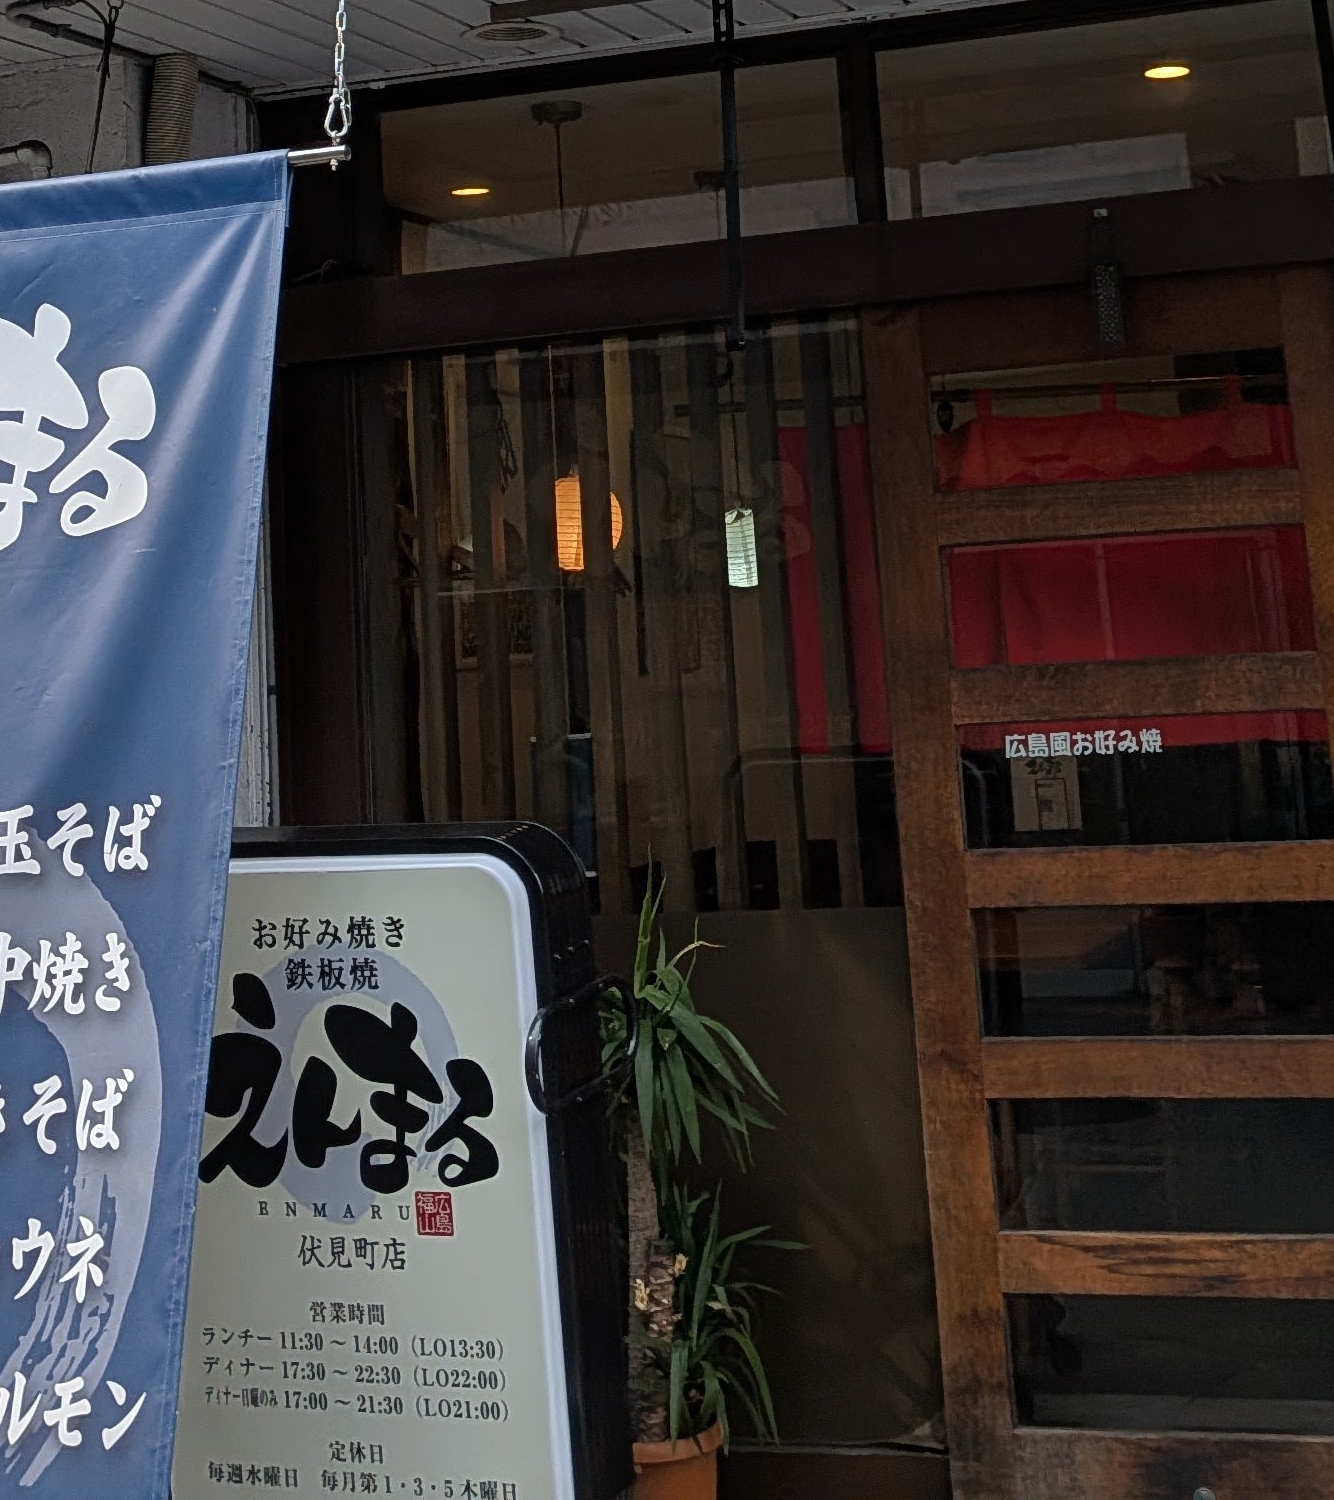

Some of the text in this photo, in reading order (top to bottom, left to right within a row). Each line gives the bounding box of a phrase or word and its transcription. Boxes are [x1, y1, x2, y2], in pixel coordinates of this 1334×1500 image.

[1005, 728, 1163, 758] 広島風お好み焼
[252, 915, 406, 950] お好み焼き
[284, 957, 380, 991] 鉄板焼
[198, 972, 500, 1194] えんまる
[258, 1200, 410, 1221] ENMARU
[297, 1233, 407, 1271] 伏見町店
[309, 1301, 385, 1326] 営業時間
[202, 1327, 272, 1347] ランチー
[280, 1331, 323, 1350] 11:30
[353, 1334, 399, 1355] 14:00
[203, 1356, 273, 1377] ディナー
[282, 1361, 326, 1381] 17:30
[354, 1364, 401, 1385] 22:30
[284, 1390, 328, 1411] 17:00
[356, 1394, 403, 1415] 21:30
[328, 1440, 384, 1464] 定休日
[208, 1461, 299, 1488] 毎週水曜日
